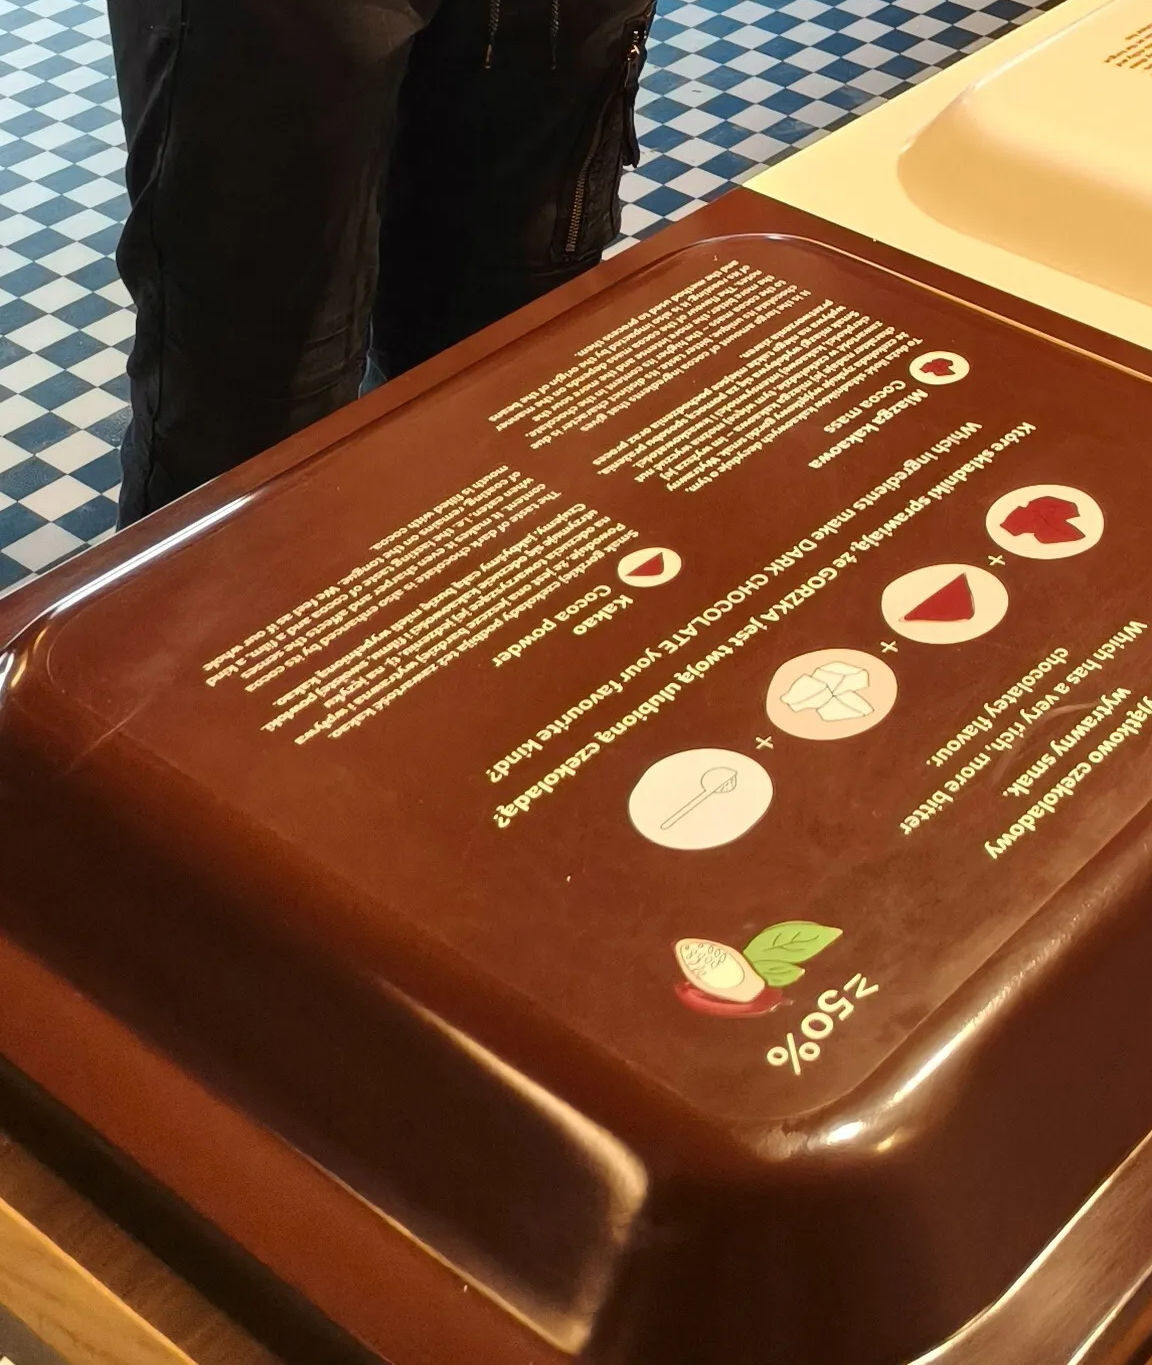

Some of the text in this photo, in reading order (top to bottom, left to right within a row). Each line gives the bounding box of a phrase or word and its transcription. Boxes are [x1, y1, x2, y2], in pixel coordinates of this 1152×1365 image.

[808, 389, 928, 469] Miazga kakaowa
[824, 380, 906, 433] Cocoa mass
[486, 422, 982, 783] Which ingredients make DARK CHOCOLATE your favourite kind?
[492, 585, 611, 667] Cocoa powder
[493, 422, 1036, 828] Które składniki sprawiają, że GORZKA jest twoją ulubioną czekoladą?
[573, 594, 633, 635] Kakao
[900, 621, 1148, 835] Which has a very rich, more bitter
[926, 648, 1069, 767] chocolatey flavour.
[1003, 688, 1131, 797] wytrawny smak.
[984, 762, 1092, 859] czekoladowy
[766, 973, 879, 1075] ≥50%
